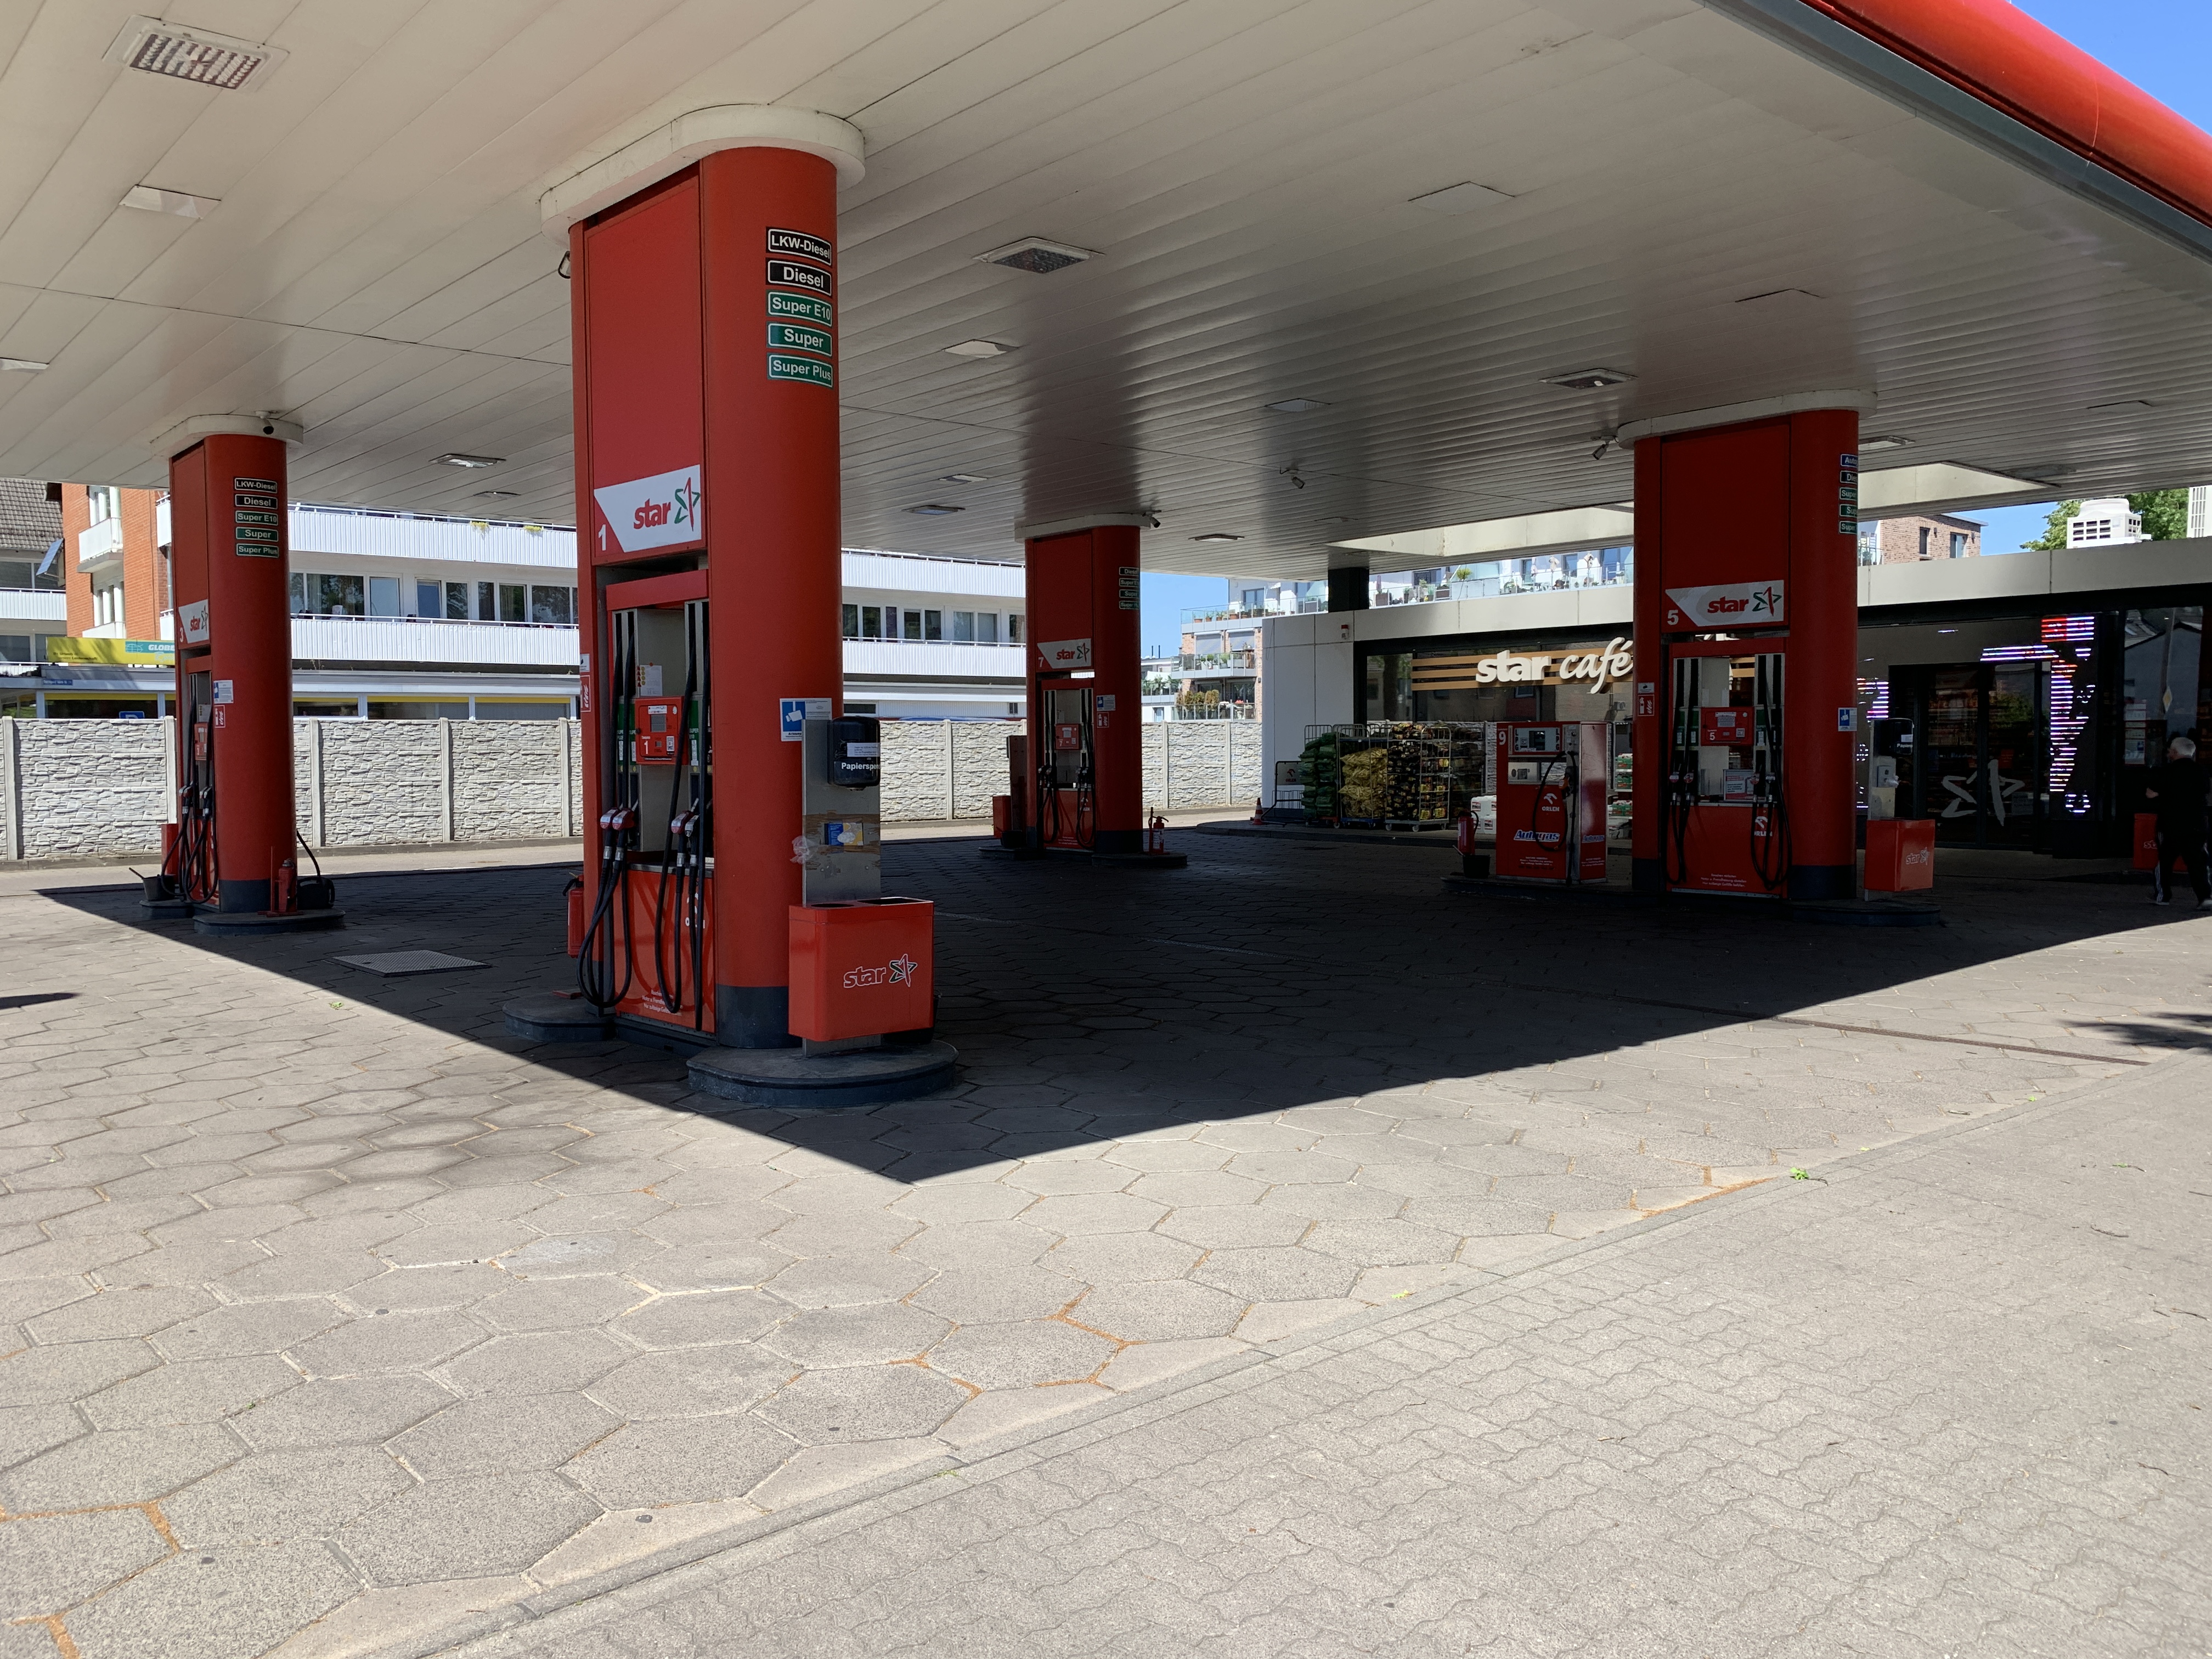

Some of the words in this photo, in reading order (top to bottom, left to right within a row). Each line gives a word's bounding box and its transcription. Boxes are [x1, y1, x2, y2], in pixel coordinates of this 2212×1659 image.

[771, 235, 830, 259] LKW-Diesel
[783, 267, 823, 288] Diesel
[772, 297, 811, 314] Super
[815, 306, 831, 320] E10
[784, 329, 823, 347] Super
[773, 359, 810, 375] Super
[812, 368, 831, 380] Plus
[236, 481, 276, 490] LKW-Diesel
[244, 497, 271, 506] Diesel
[238, 514, 262, 522] Super
[634, 498, 671, 529] star
[245, 529, 272, 539] Super
[598, 524, 606, 551] 1
[239, 546, 262, 554] Super
[1707, 596, 1749, 613] star
[190, 616, 200, 631] star
[1667, 610, 1679, 625] 5
[179, 627, 184, 642] 3
[1056, 648, 1075, 660] star
[1038, 657, 1044, 668] 7
[1476, 650, 1551, 683] star
[1559, 637, 1633, 694] café
[1499, 731, 1506, 745] 9
[1709, 732, 1716, 741] 5
[644, 740, 648, 755] 1
[1906, 853, 1920, 865] star
[843, 966, 887, 988] star
